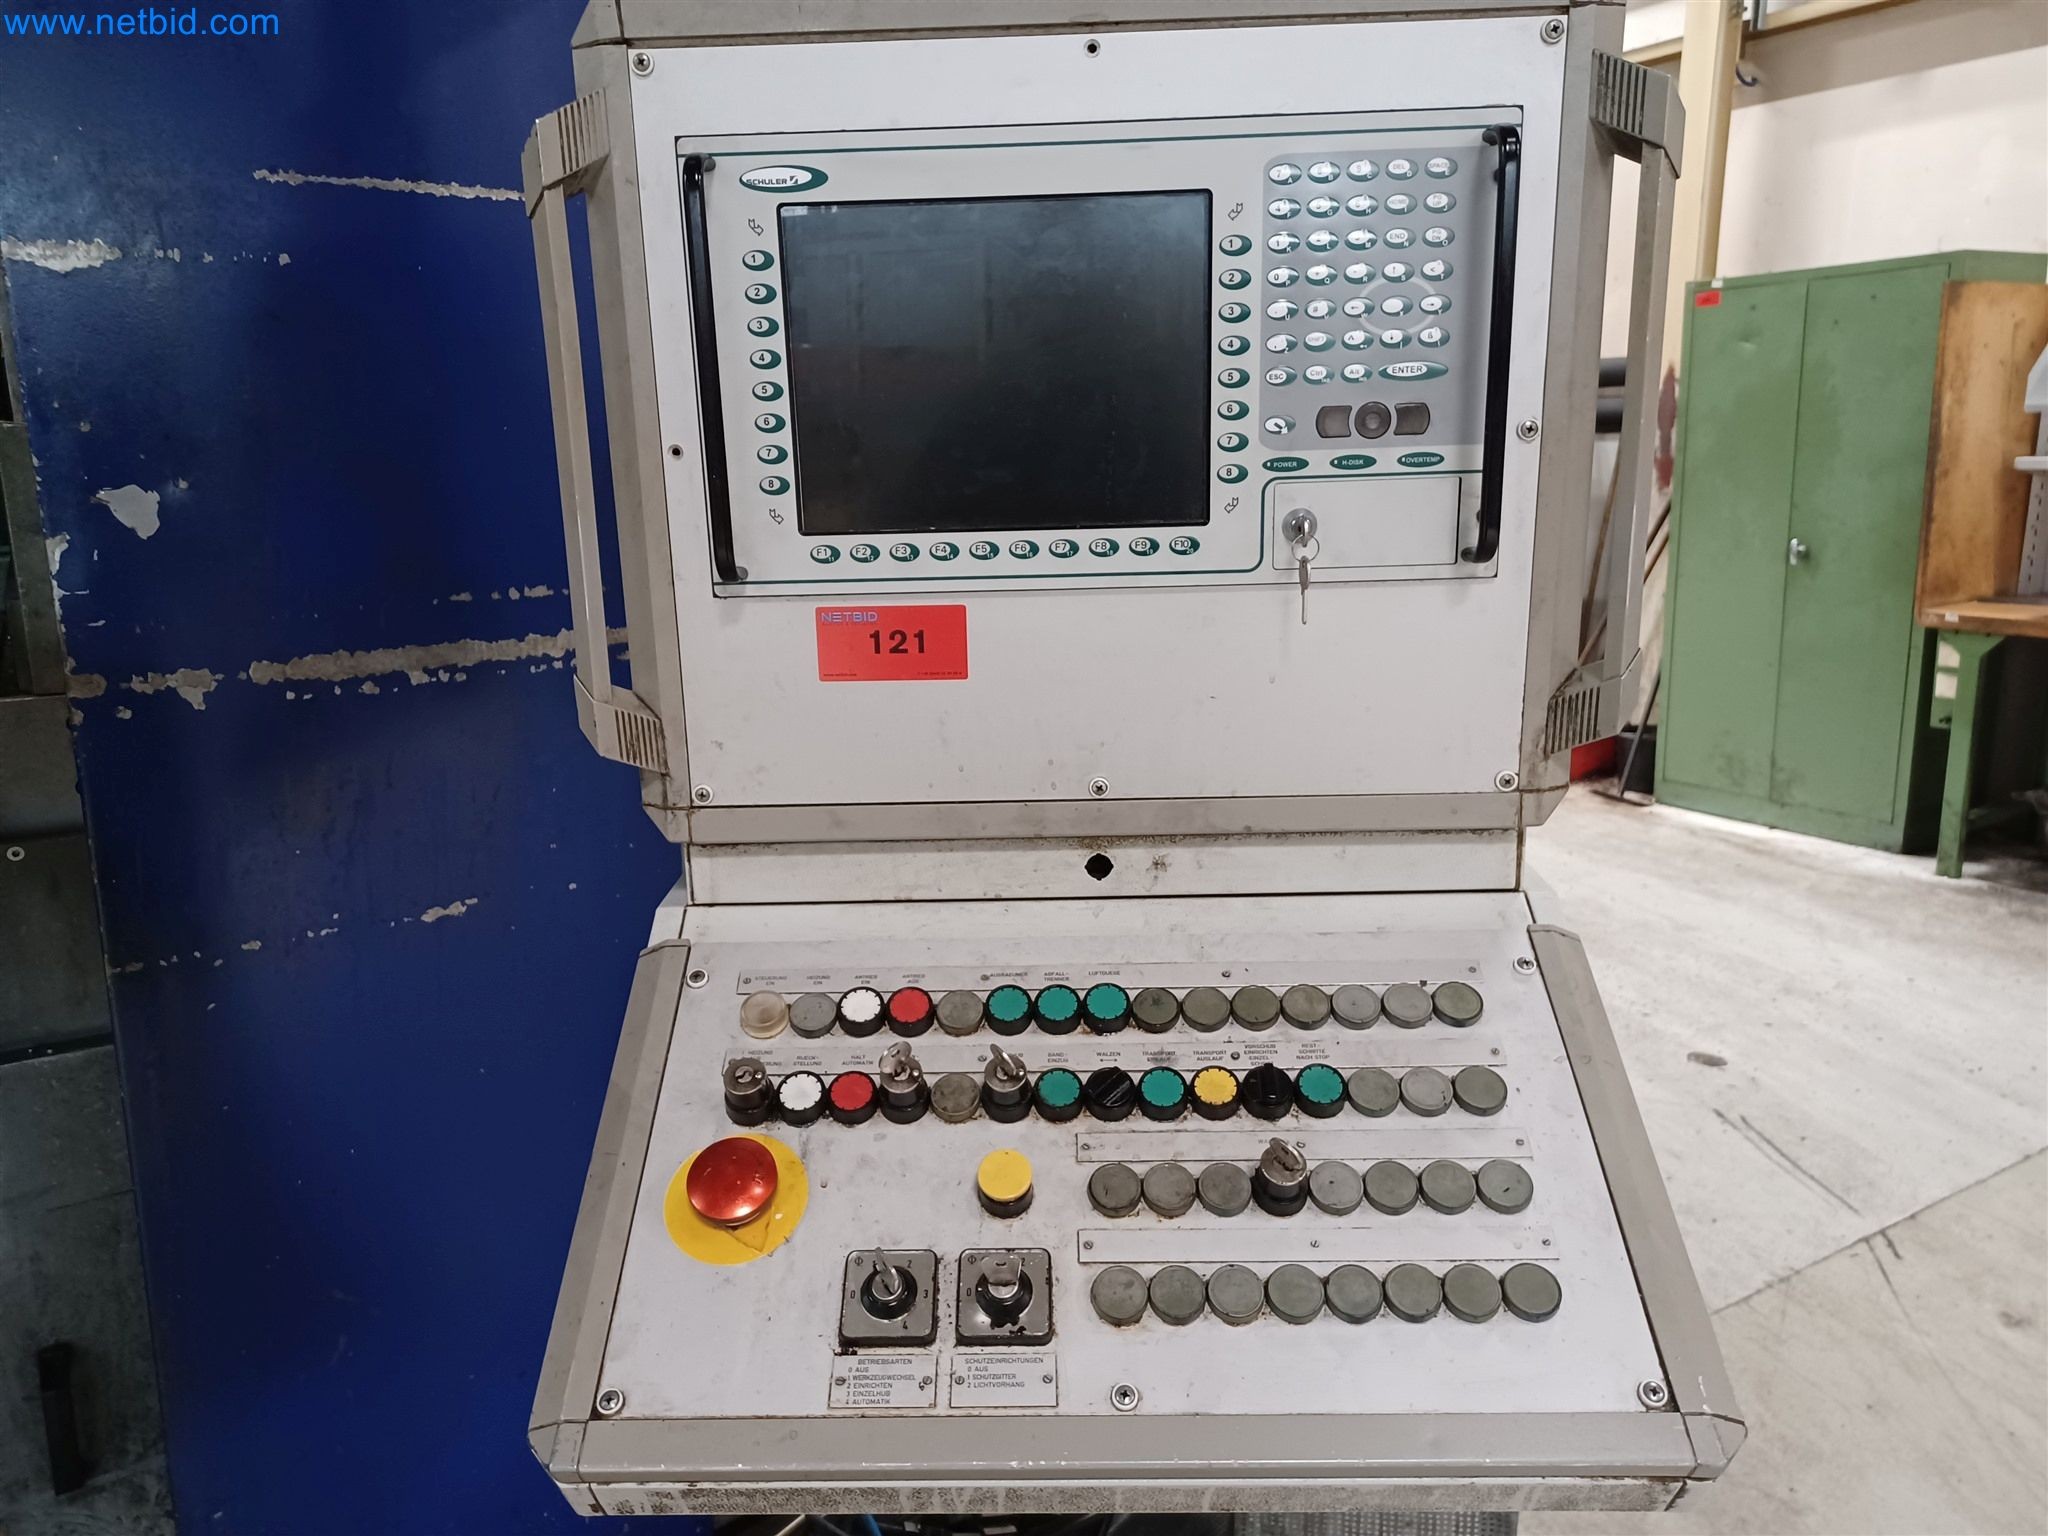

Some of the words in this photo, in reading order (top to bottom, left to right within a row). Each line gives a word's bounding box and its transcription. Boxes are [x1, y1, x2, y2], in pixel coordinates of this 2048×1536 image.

[746, 178, 788, 186] SCHULER
[1228, 239, 1233, 248] 1
[750, 254, 756, 264] 1
[1228, 272, 1235, 282] 2
[754, 288, 760, 297] 2
[1228, 306, 1234, 316] 3
[756, 320, 763, 330] 3
[1227, 340, 1234, 348] 4
[758, 353, 765, 362] 4
[1392, 366, 1423, 374] ENTER
[1227, 372, 1234, 381] 5
[762, 385, 768, 394] 5
[1226, 404, 1232, 414] 6
[764, 417, 770, 426] 6
[1226, 436, 1232, 445] 7
[766, 448, 772, 458] 7
[1226, 468, 1232, 476] 8
[768, 480, 774, 488] 8
[1014, 544, 1026, 552] F6
[1055, 543, 1067, 551] F7
[1095, 542, 1108, 550] F8
[1135, 541, 1147, 549] F9
[1174, 540, 1188, 548] F10
[816, 549, 828, 557] F1
[895, 546, 908, 554] F3
[935, 546, 947, 554] F4
[821, 611, 878, 622] NETBID
[869, 629, 926, 654] 121
[907, 1260, 912, 1269] 2
[850, 1290, 856, 1300] 0
[923, 1290, 928, 1299] 3
[966, 1288, 972, 1297] 0
[902, 1321, 908, 1330] 4
